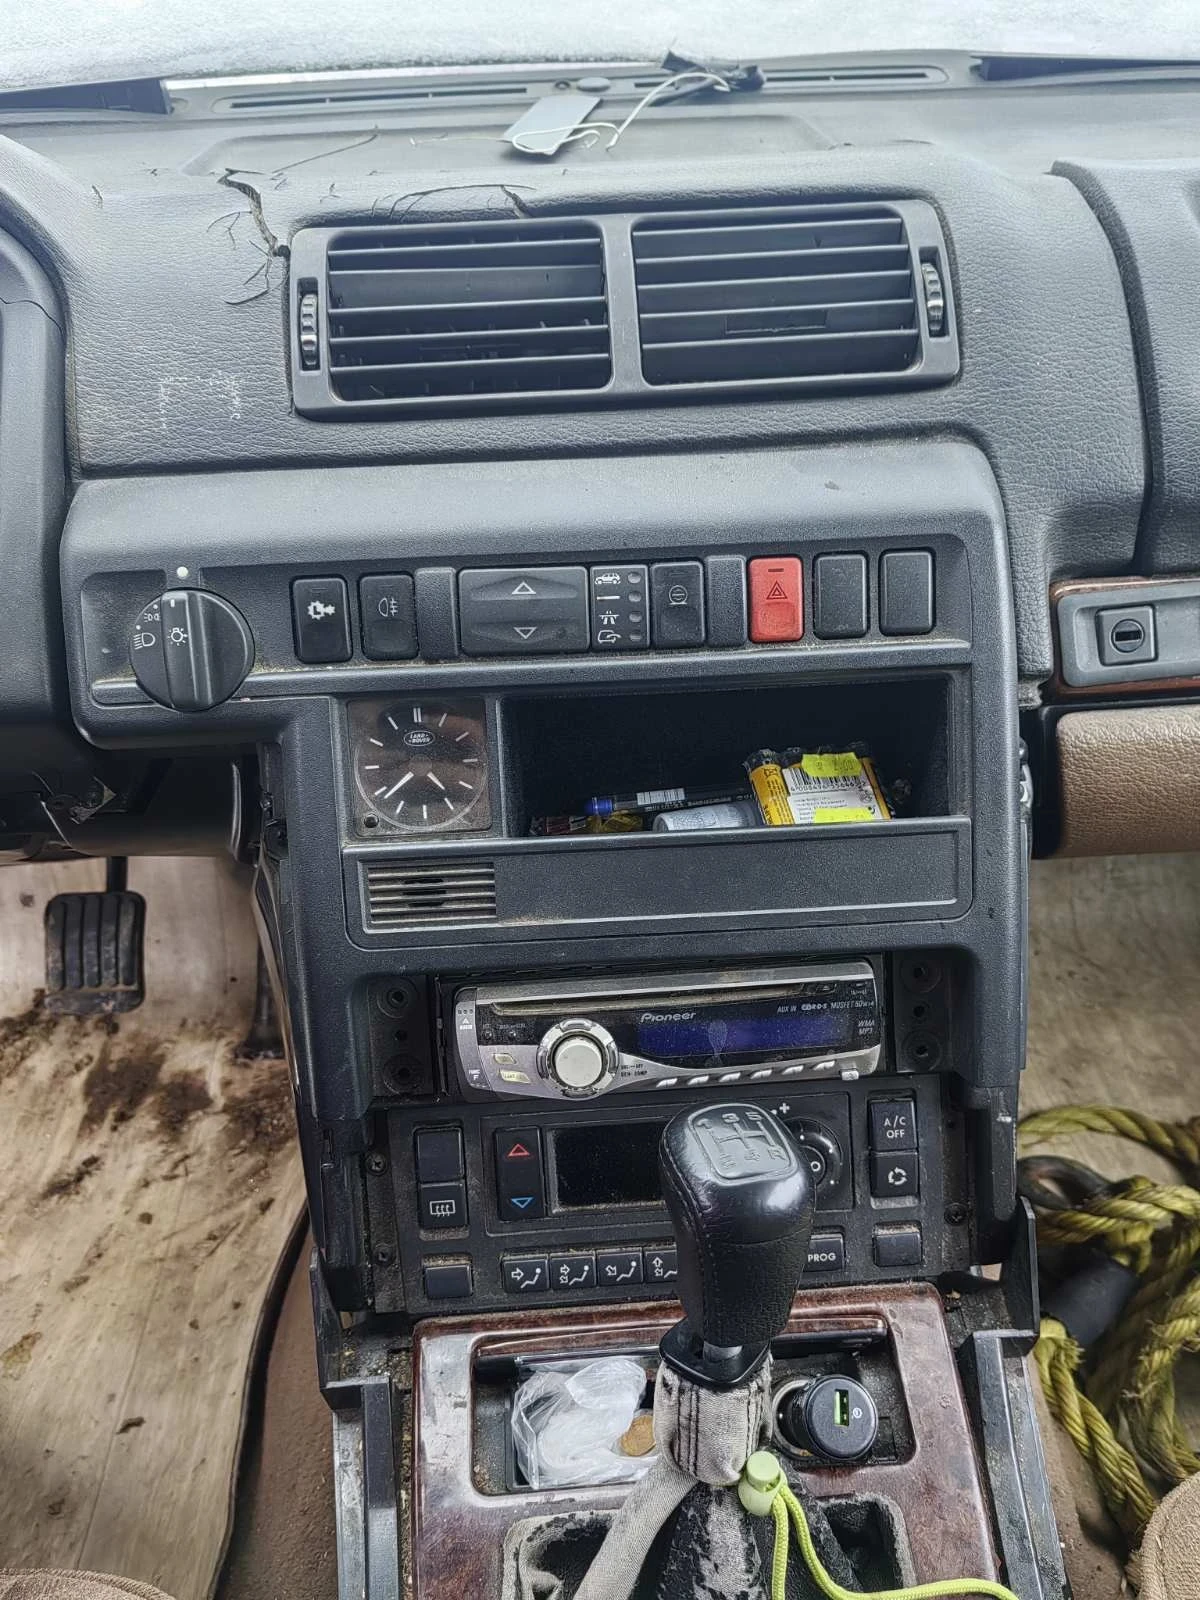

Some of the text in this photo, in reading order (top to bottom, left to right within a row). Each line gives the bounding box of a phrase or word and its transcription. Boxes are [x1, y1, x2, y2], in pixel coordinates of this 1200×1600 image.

[640, 1011, 697, 1023] Pioneer
[722, 1113, 740, 1124] 3
[745, 1111, 762, 1121] 5
[884, 1115, 907, 1128] A/C
[886, 1129, 905, 1139] OFF
[807, 1252, 836, 1262] PROG
